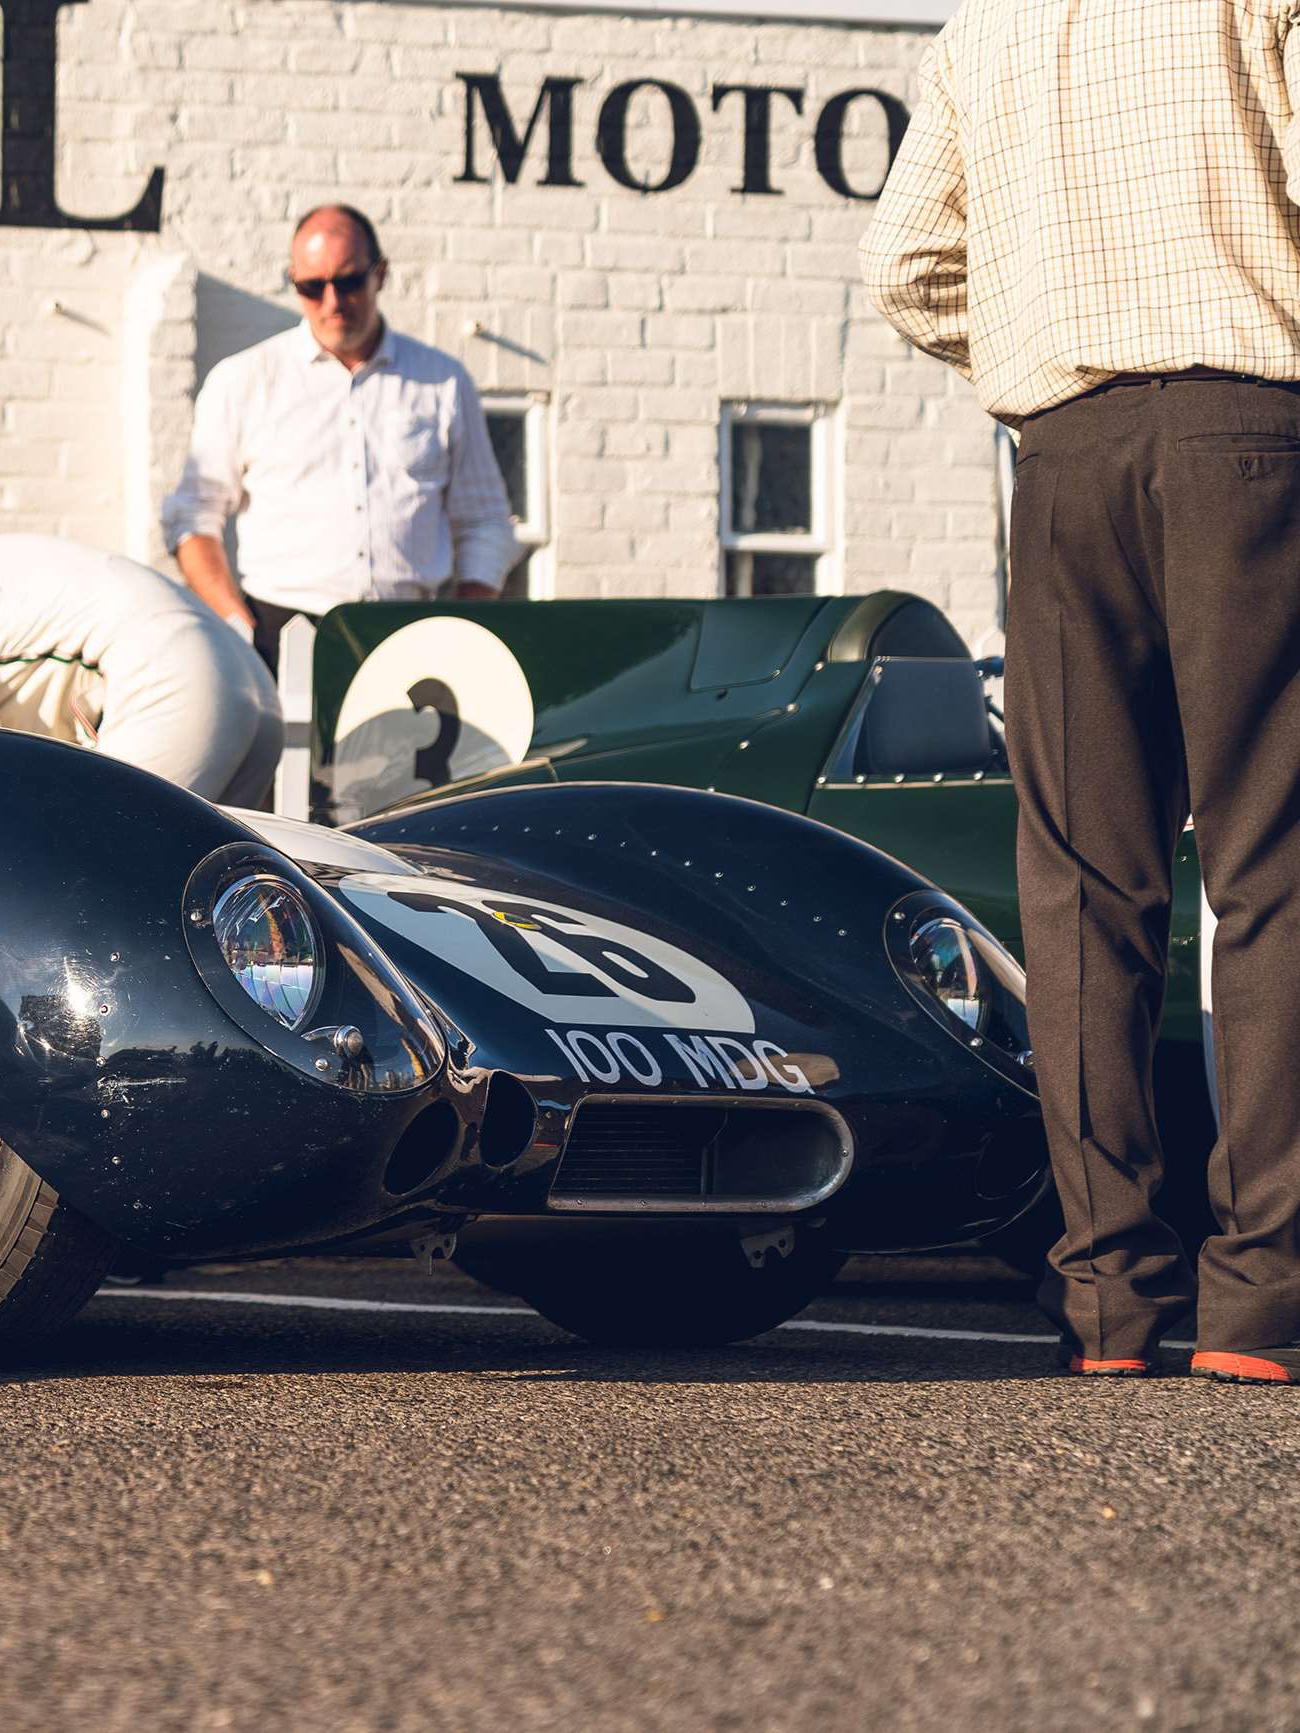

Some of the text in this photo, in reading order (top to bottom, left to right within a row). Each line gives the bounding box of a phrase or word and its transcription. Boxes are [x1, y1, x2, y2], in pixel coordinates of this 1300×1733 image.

[388, 890, 697, 1003] 26
[545, 1028, 816, 1095] 100 MDG
